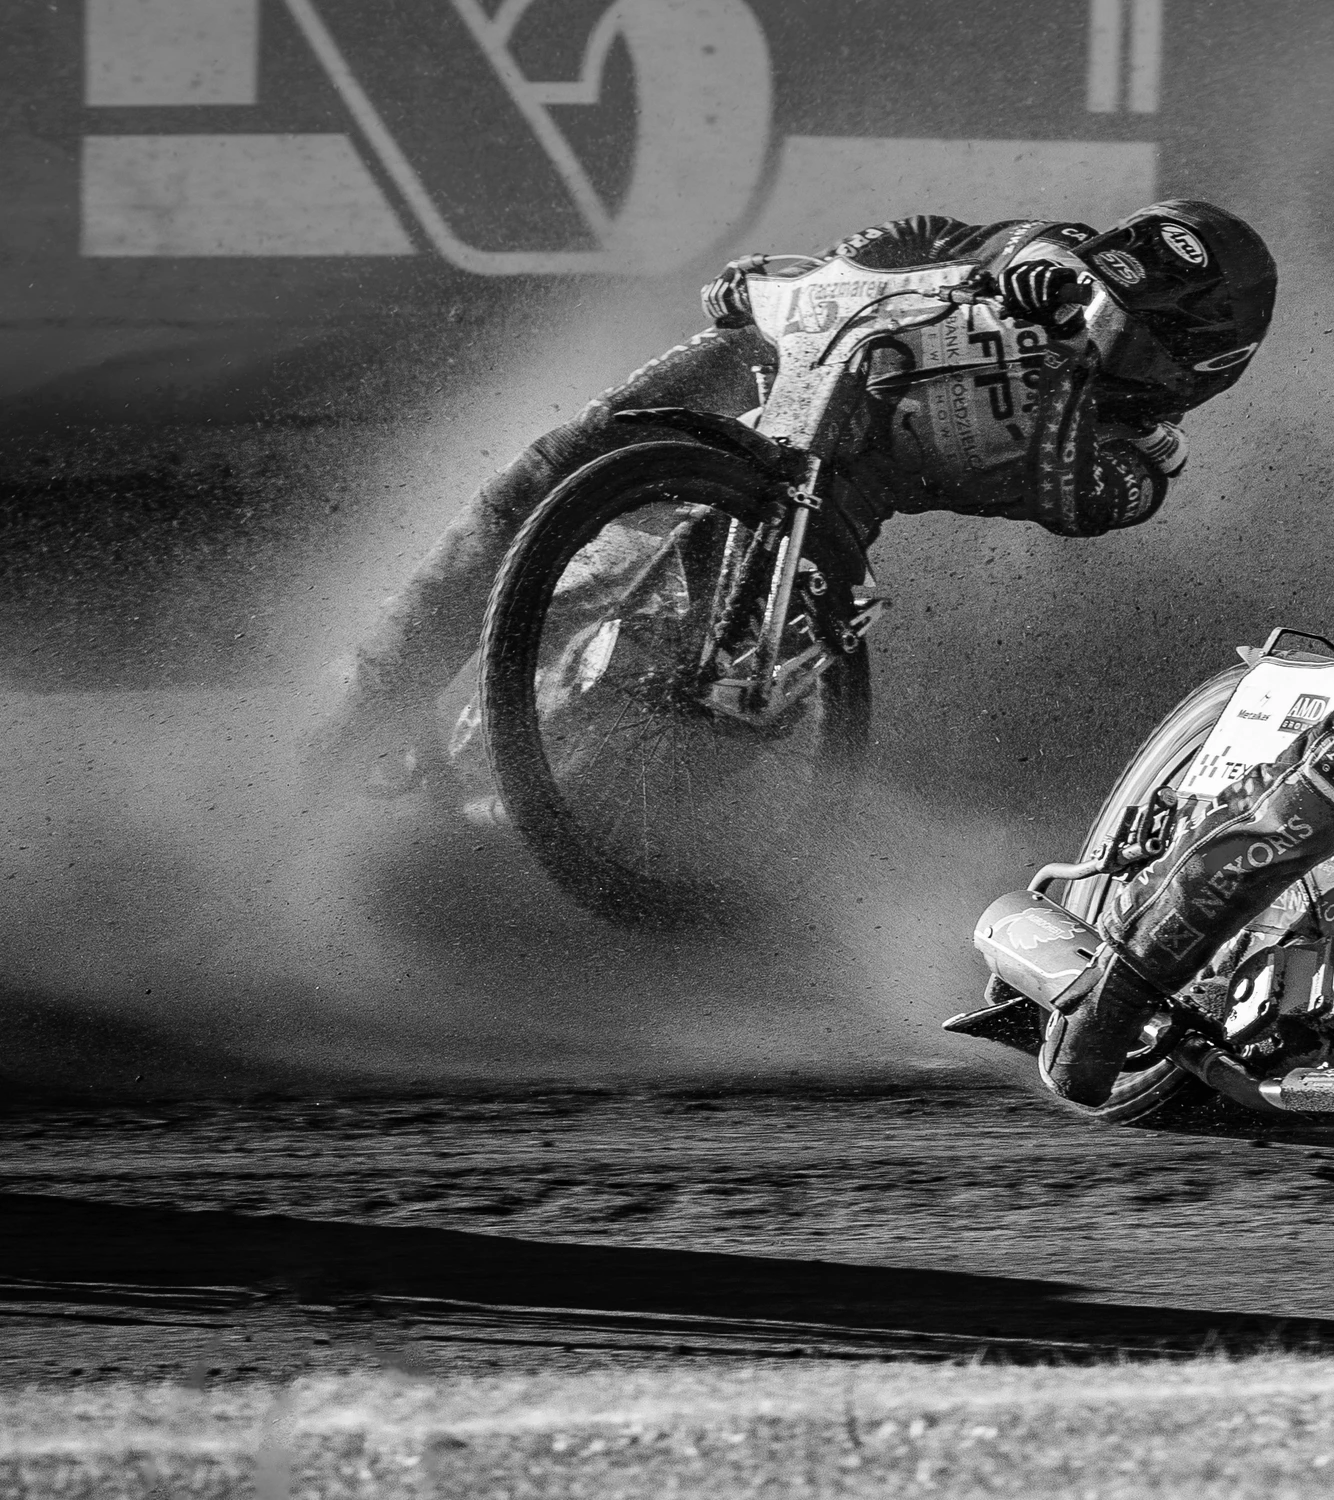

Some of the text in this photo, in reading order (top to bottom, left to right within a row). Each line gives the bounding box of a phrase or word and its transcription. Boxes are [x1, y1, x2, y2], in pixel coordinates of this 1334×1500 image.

[1162, 225, 1204, 264] Arai
[1287, 696, 1328, 721] AMD
[1280, 719, 1314, 732] GROU
[1221, 760, 1254, 781] TEX
[1191, 814, 1314, 919] NEXORIS
